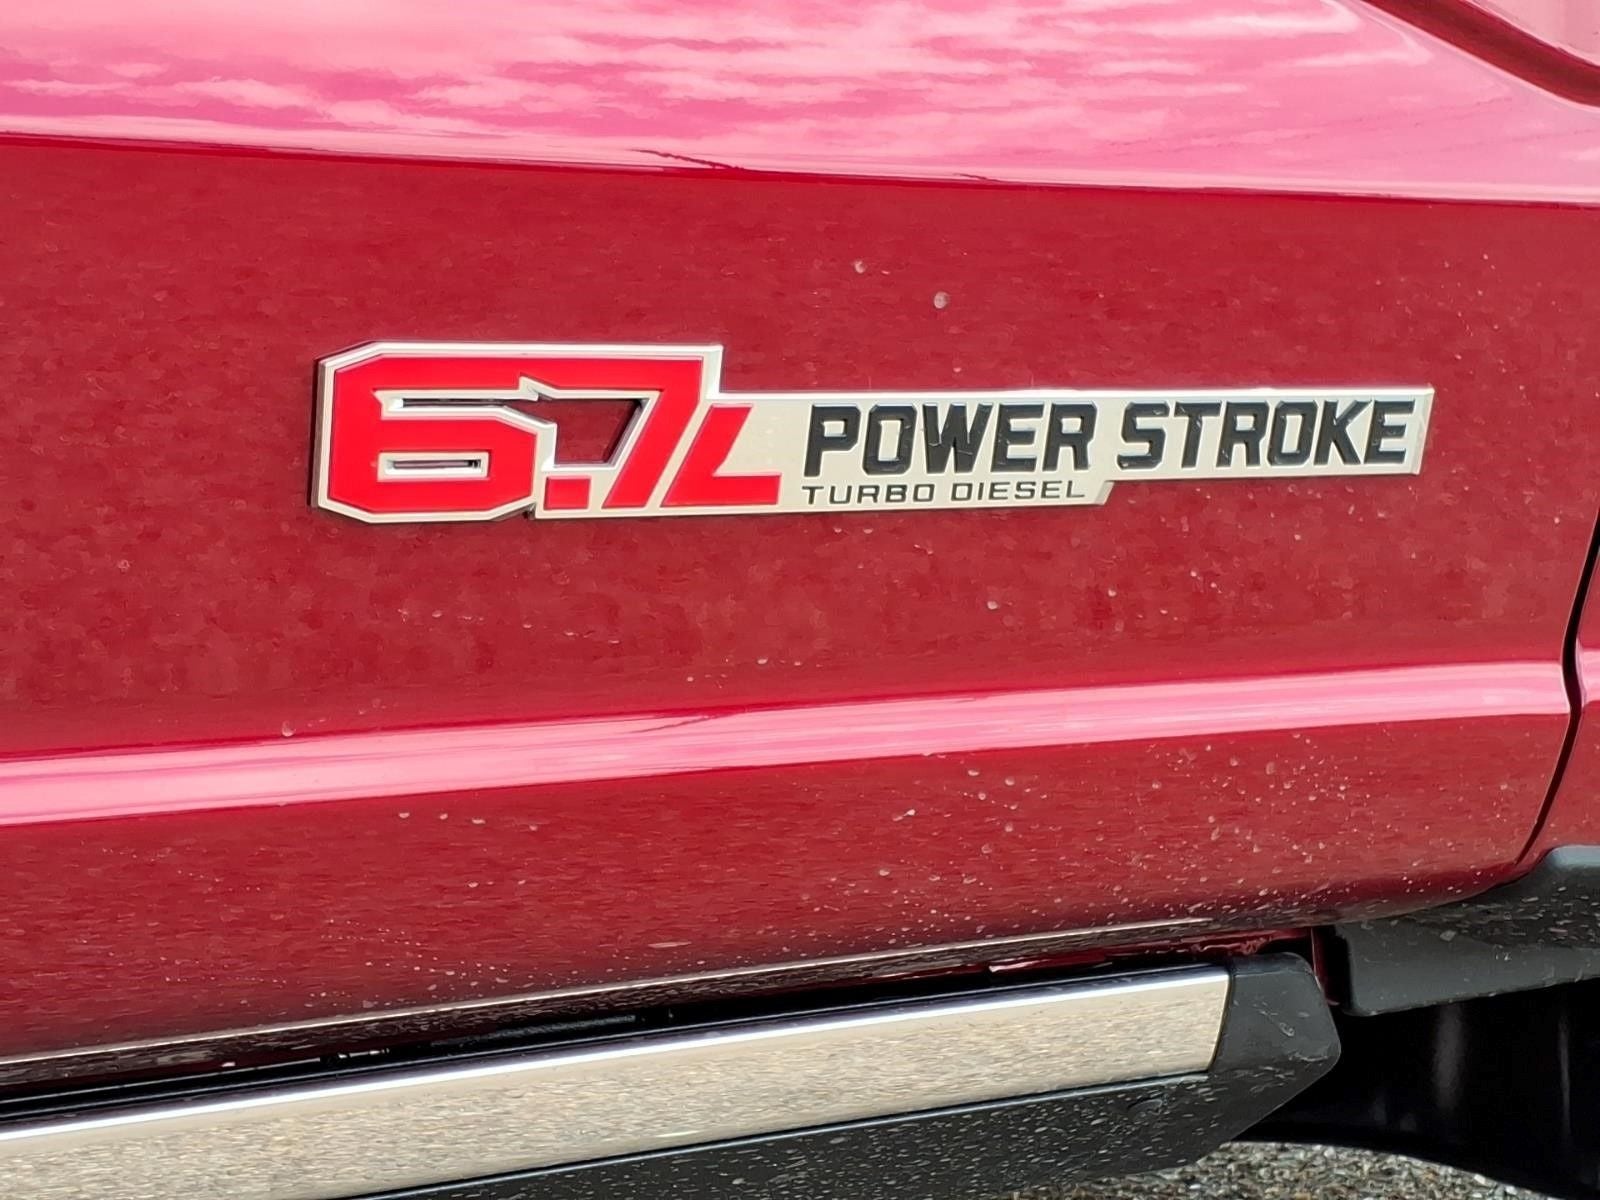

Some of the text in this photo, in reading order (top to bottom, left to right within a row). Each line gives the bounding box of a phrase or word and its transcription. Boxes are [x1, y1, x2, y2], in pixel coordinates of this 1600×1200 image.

[328, 355, 781, 513] 6.7L
[803, 399, 1416, 478] POWER STROKE
[801, 480, 1086, 506] TURBO DIESEL
